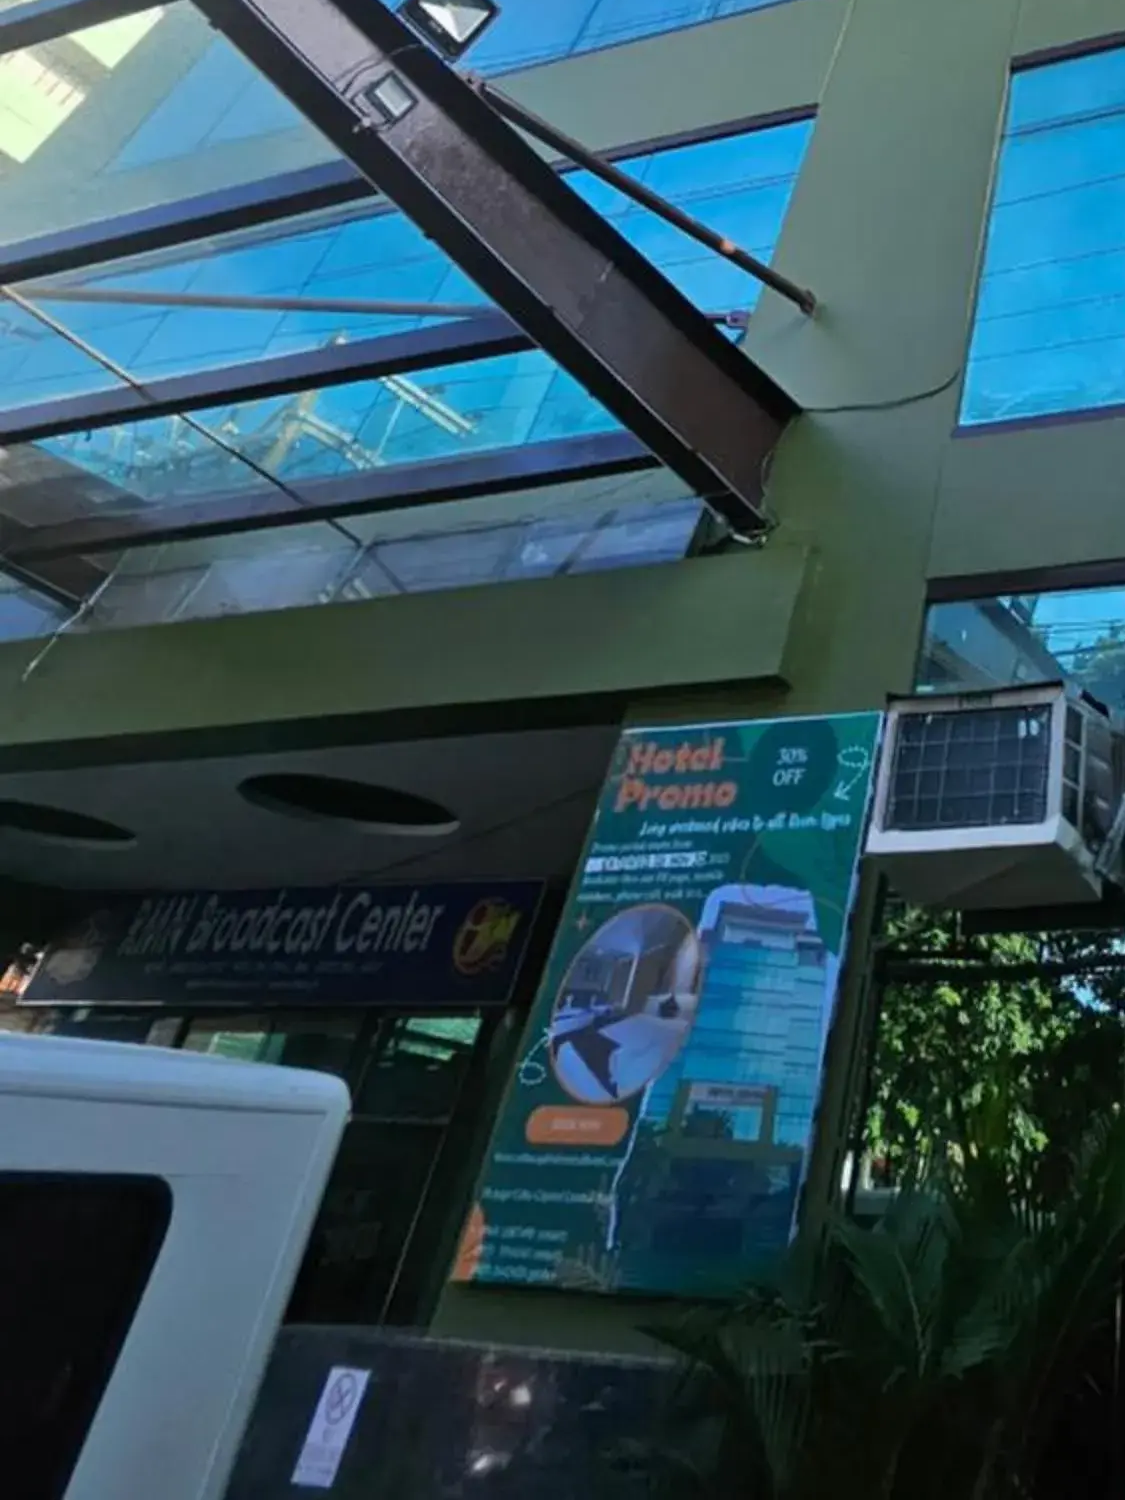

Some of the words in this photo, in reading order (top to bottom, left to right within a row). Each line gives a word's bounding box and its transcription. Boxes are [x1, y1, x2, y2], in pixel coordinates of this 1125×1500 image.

[628, 736, 726, 775] Hotel
[772, 767, 807, 787] OFF
[613, 780, 738, 814] Promo
[185, 888, 344, 955] Broadcast
[334, 890, 446, 953] Center
